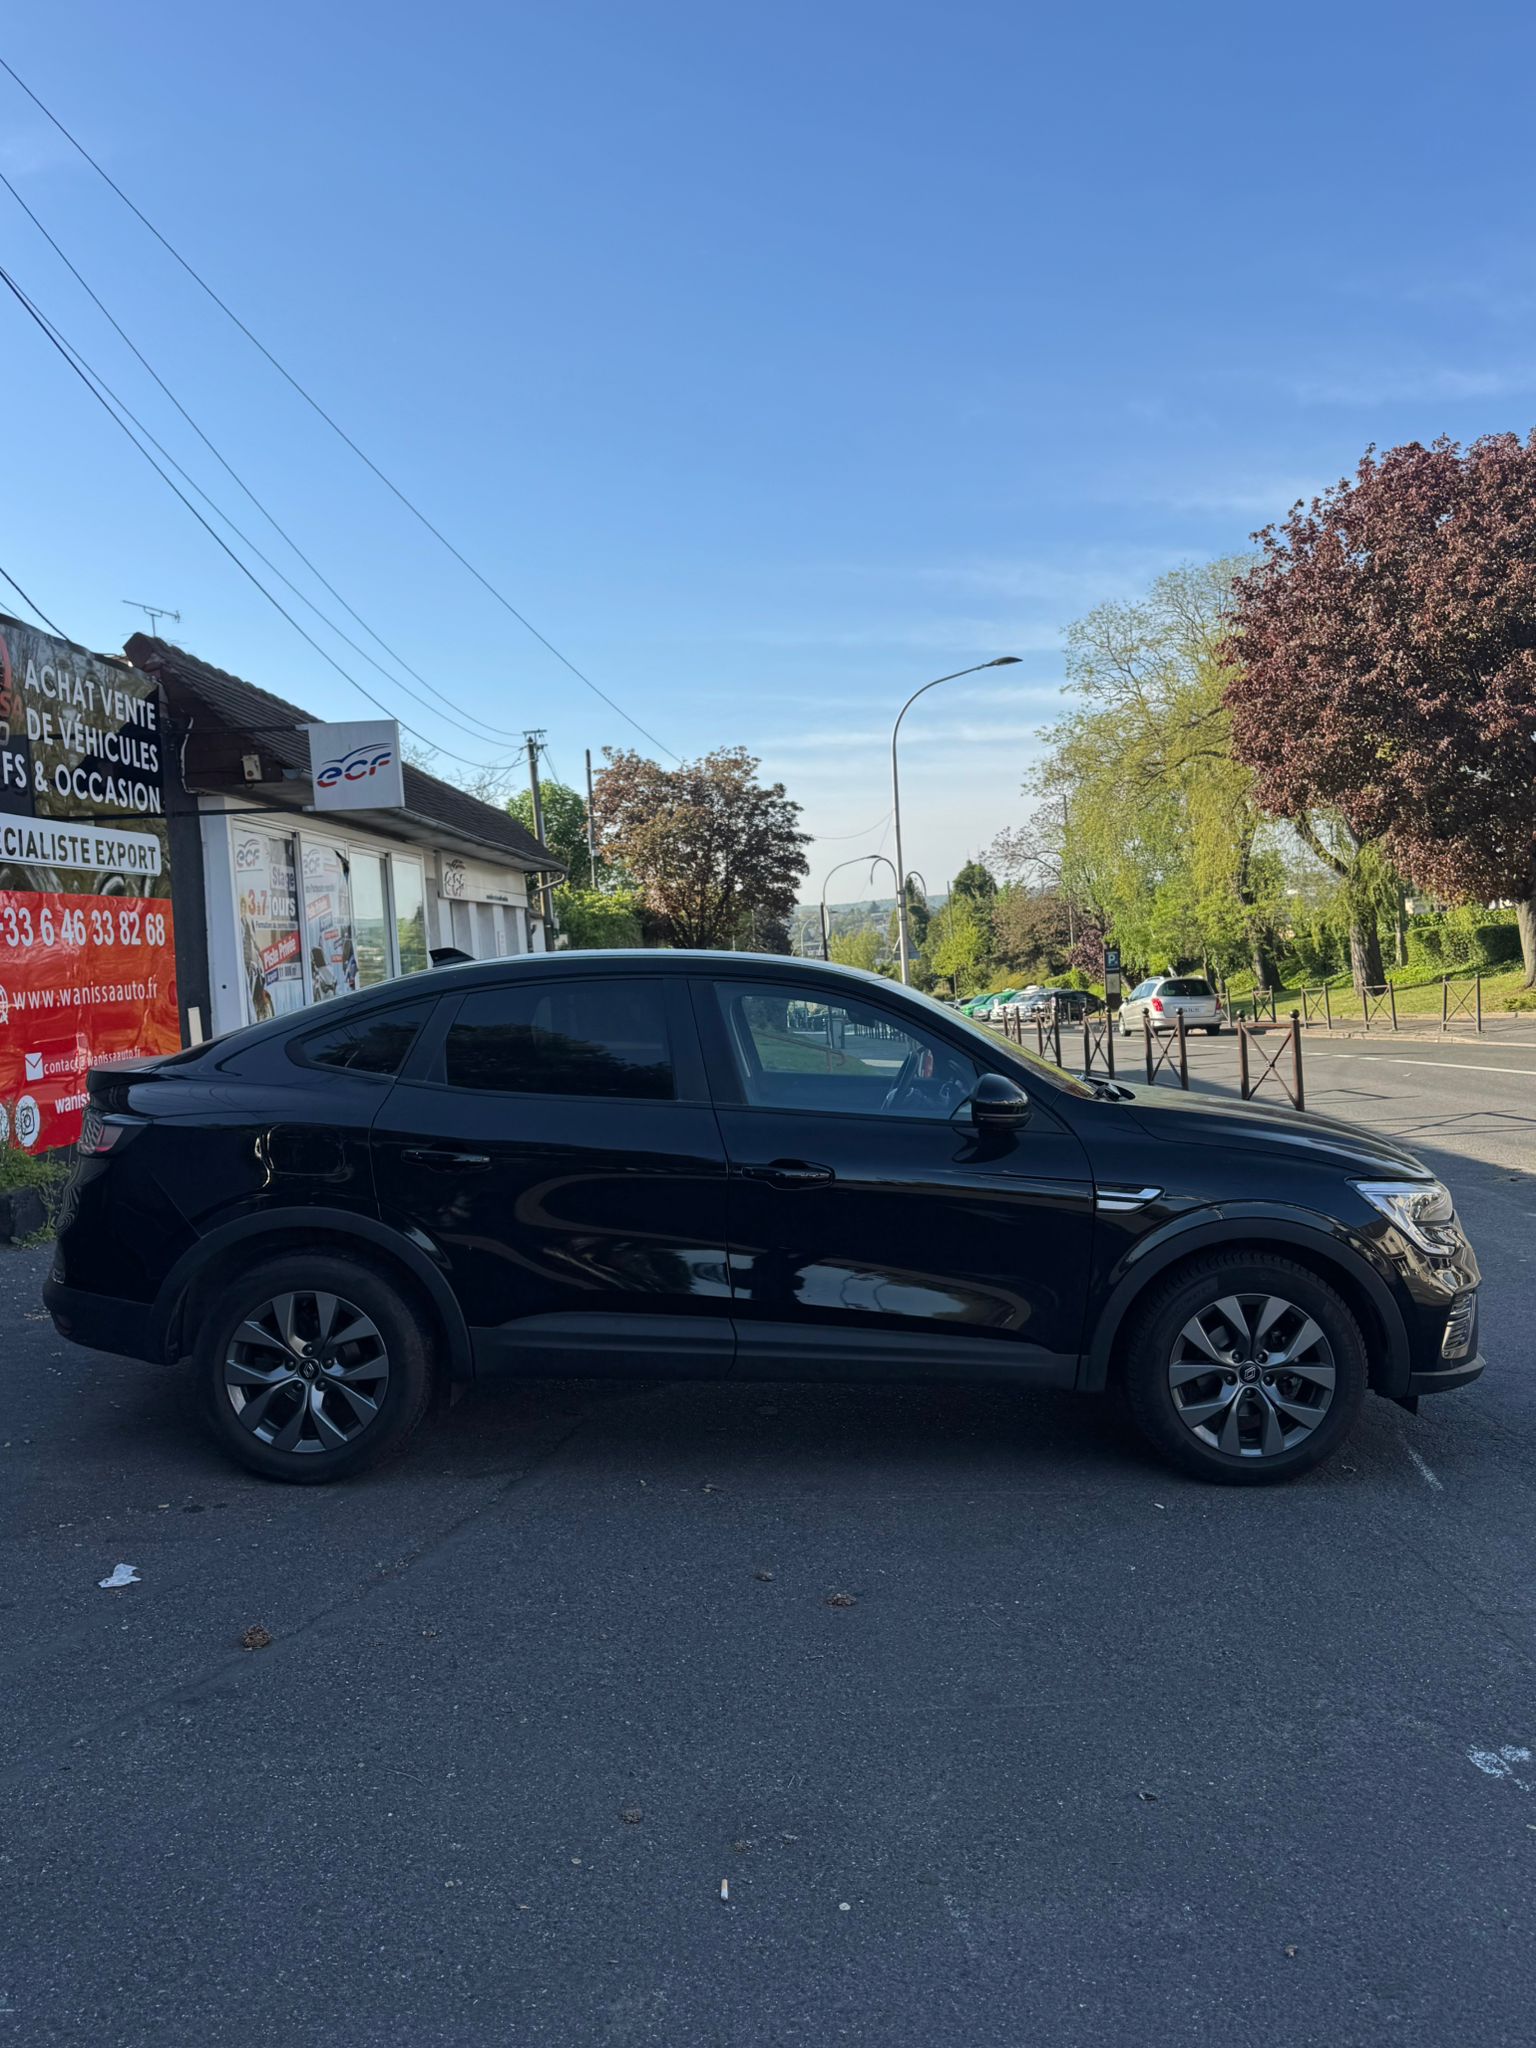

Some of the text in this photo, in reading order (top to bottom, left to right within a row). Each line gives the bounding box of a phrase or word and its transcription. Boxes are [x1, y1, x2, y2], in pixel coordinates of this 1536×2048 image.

[25, 660, 156, 731] ACHAT VENTE
[27, 707, 53, 745] DE
[59, 713, 158, 773] VÉHICULES
[35, 761, 49, 793] &
[55, 764, 161, 814] OCCASION
[95, 840, 156, 870] EXPORT
[40, 908, 55, 946] 6
[61, 909, 87, 945] 46
[91, 909, 115, 945] 33
[119, 911, 141, 945] 82
[145, 913, 165, 946] 68
[13, 976, 158, 1011] www.wanissaauto.fr
